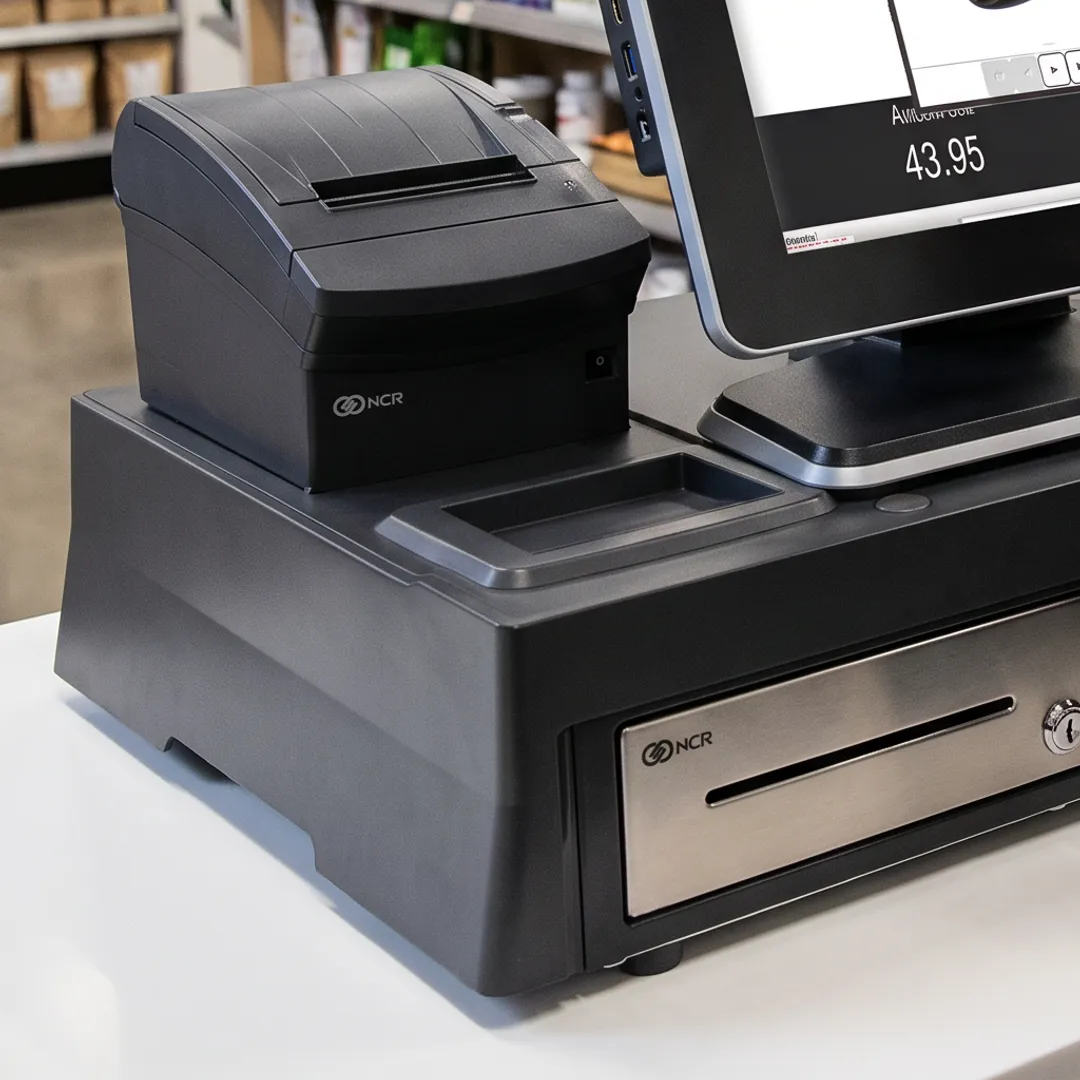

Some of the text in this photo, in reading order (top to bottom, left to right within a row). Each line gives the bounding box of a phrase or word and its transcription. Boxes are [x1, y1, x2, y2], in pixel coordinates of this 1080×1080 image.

[905, 134, 986, 181] 43.95
[367, 391, 404, 410] NCR
[675, 730, 714, 756] NCR
